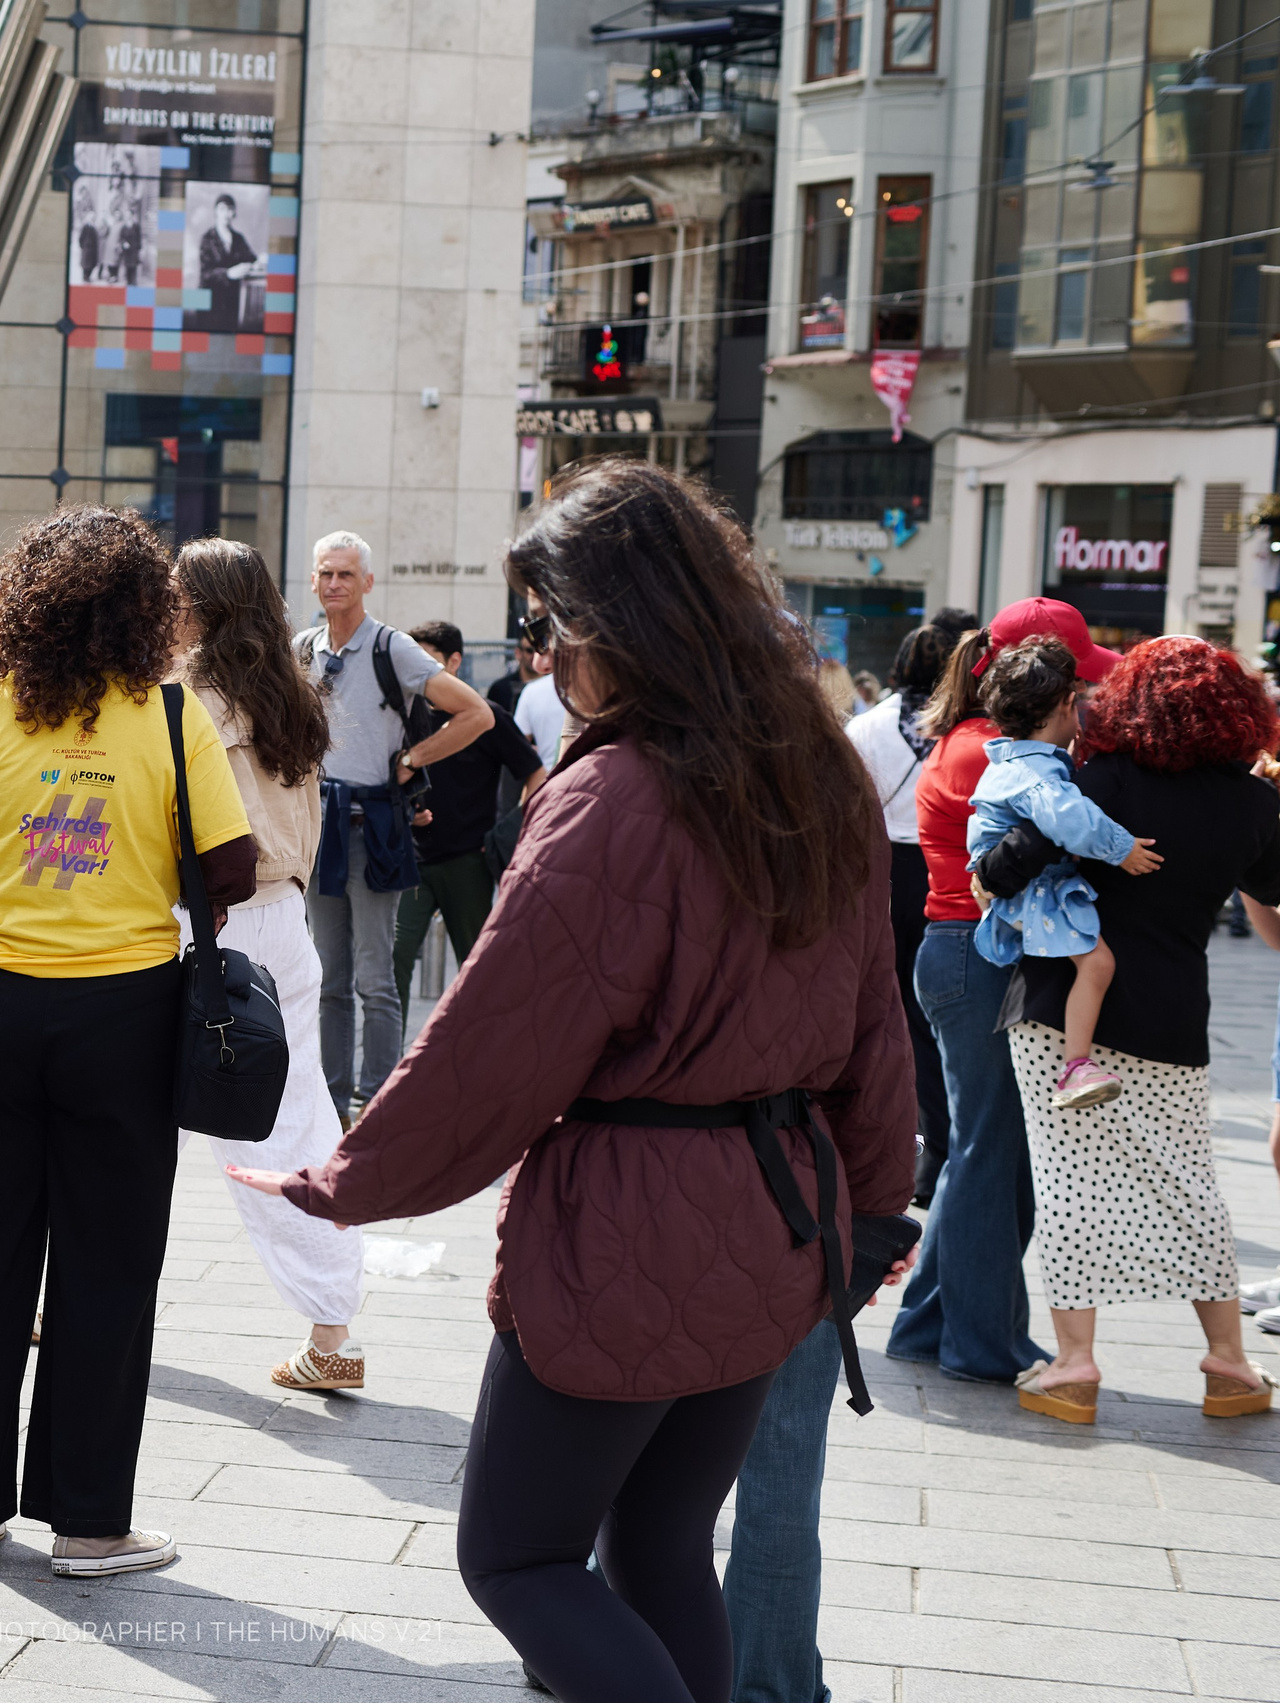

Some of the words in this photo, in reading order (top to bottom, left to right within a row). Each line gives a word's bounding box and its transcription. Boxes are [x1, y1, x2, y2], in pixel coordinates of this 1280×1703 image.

[105, 42, 202, 77] YÜZYILIN
[209, 47, 276, 82] İZLERİ
[104, 107, 168, 128] IMPRINTS
[171, 111, 189, 128] ON
[192, 112, 216, 130] THE
[219, 113, 276, 133] CENTURY
[1054, 526, 1167, 572] flormar
[79, 771, 116, 783] FOTON
[19, 813, 103, 835] Şehirde
[24, 823, 114, 871] Festival
[61, 854, 109, 876] Var!
